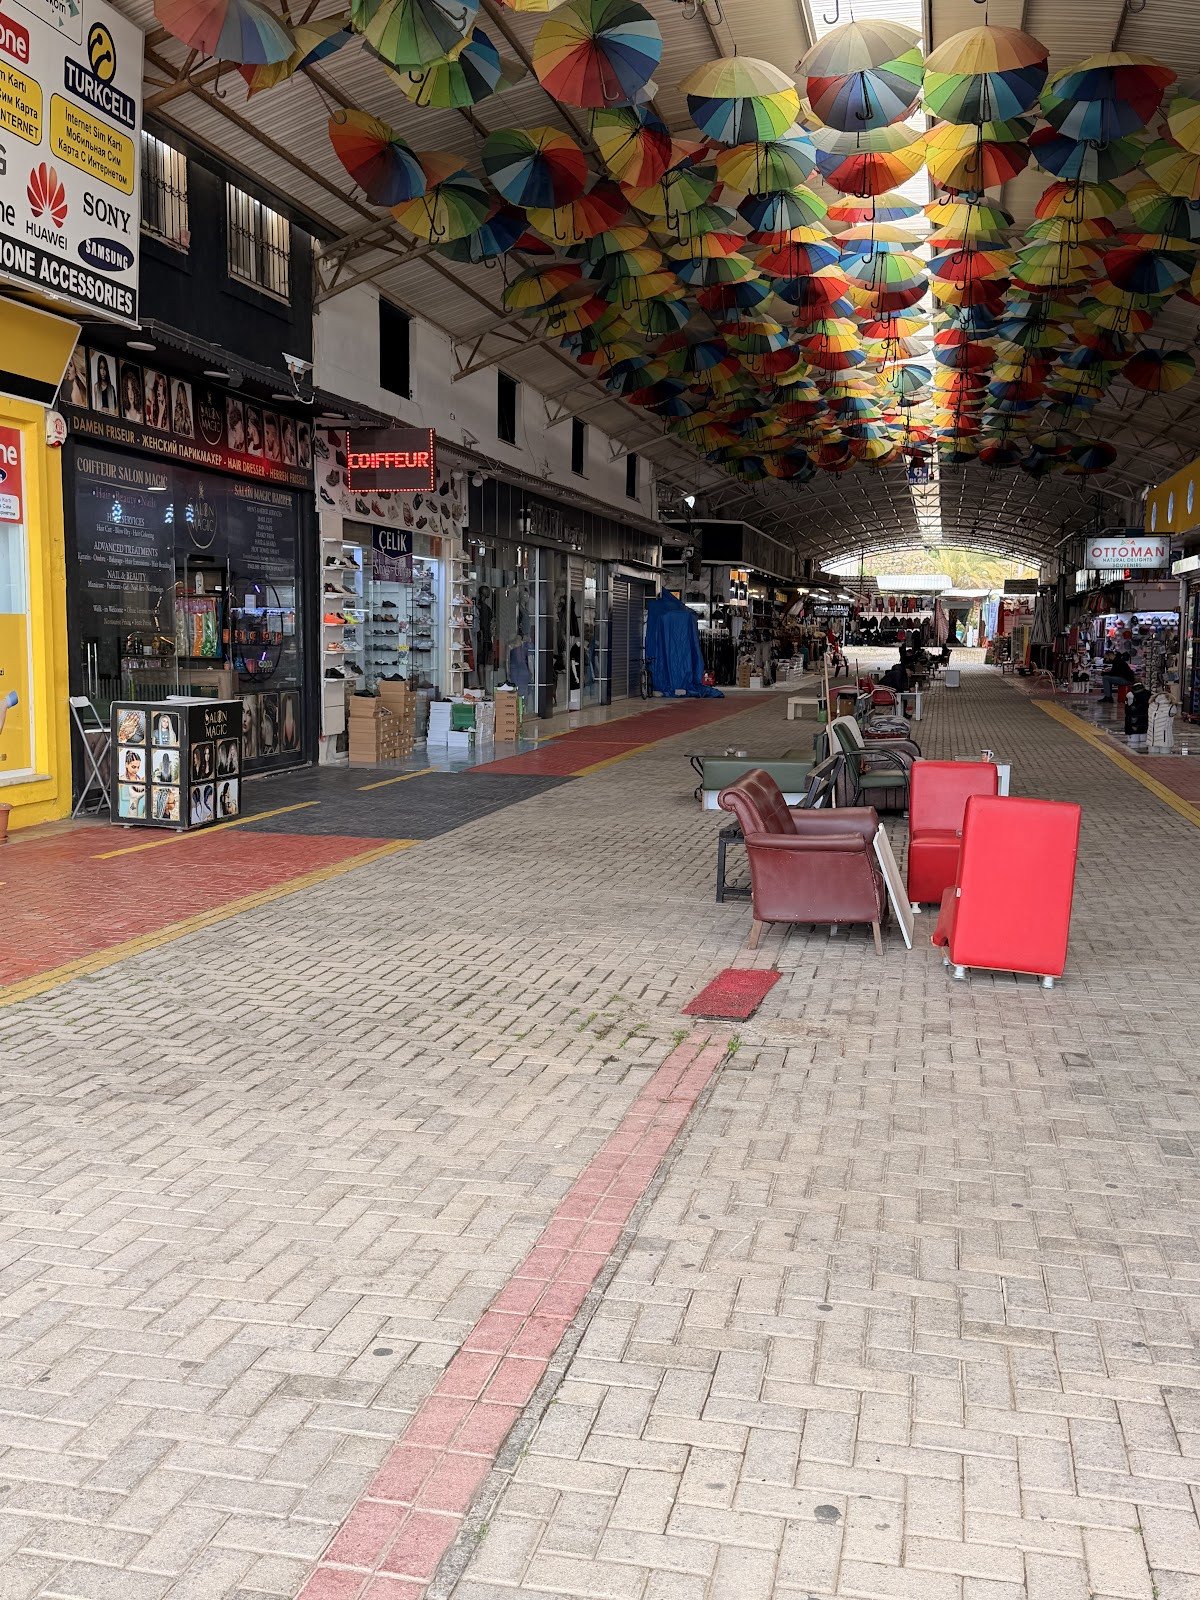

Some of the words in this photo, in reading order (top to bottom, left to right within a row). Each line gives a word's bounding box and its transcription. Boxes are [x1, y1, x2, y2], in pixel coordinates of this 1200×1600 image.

[8, 72, 27, 93] Kartı
[66, 62, 134, 126] TURKCELL
[15, 96, 38, 119] Карта
[66, 125, 106, 158] Мобильная
[107, 149, 121, 166] Сим
[93, 128, 106, 142] Sim
[107, 134, 123, 152] Kartı
[58, 137, 79, 159] Карта
[87, 155, 128, 186] Интернетом
[83, 191, 131, 234] SONY
[26, 220, 68, 250] HUAWEI
[85, 238, 128, 270] SAMSUNG
[39, 257, 133, 315] ACCESSORIES
[72, 415, 104, 436] DAMEN
[106, 424, 135, 444] FRISEUR
[142, 434, 177, 455] ЖЕНСКИЙ
[179, 444, 222, 466] ПАРИКМАХЕР
[227, 457, 242, 471] HAIR
[242, 461, 266, 477] DRESSER
[348, 452, 429, 469] COIFFEUR
[77, 457, 117, 479] COIFFEUR
[118, 466, 144, 484] SALON
[144, 471, 168, 488] MAGIC
[121, 515, 145, 526] SERVICES
[93, 541, 124, 553] ADVANCED
[124, 544, 158, 557] TREATMENTS
[378, 530, 407, 553] ÇELİK
[1091, 547, 1165, 558] OTTOMAN
[107, 570, 121, 579] NAIL
[121, 572, 126, 580] &
[126, 571, 147, 582] BEAUTY
[204, 709, 228, 726] SALON
[205, 723, 228, 739] MAGIC
